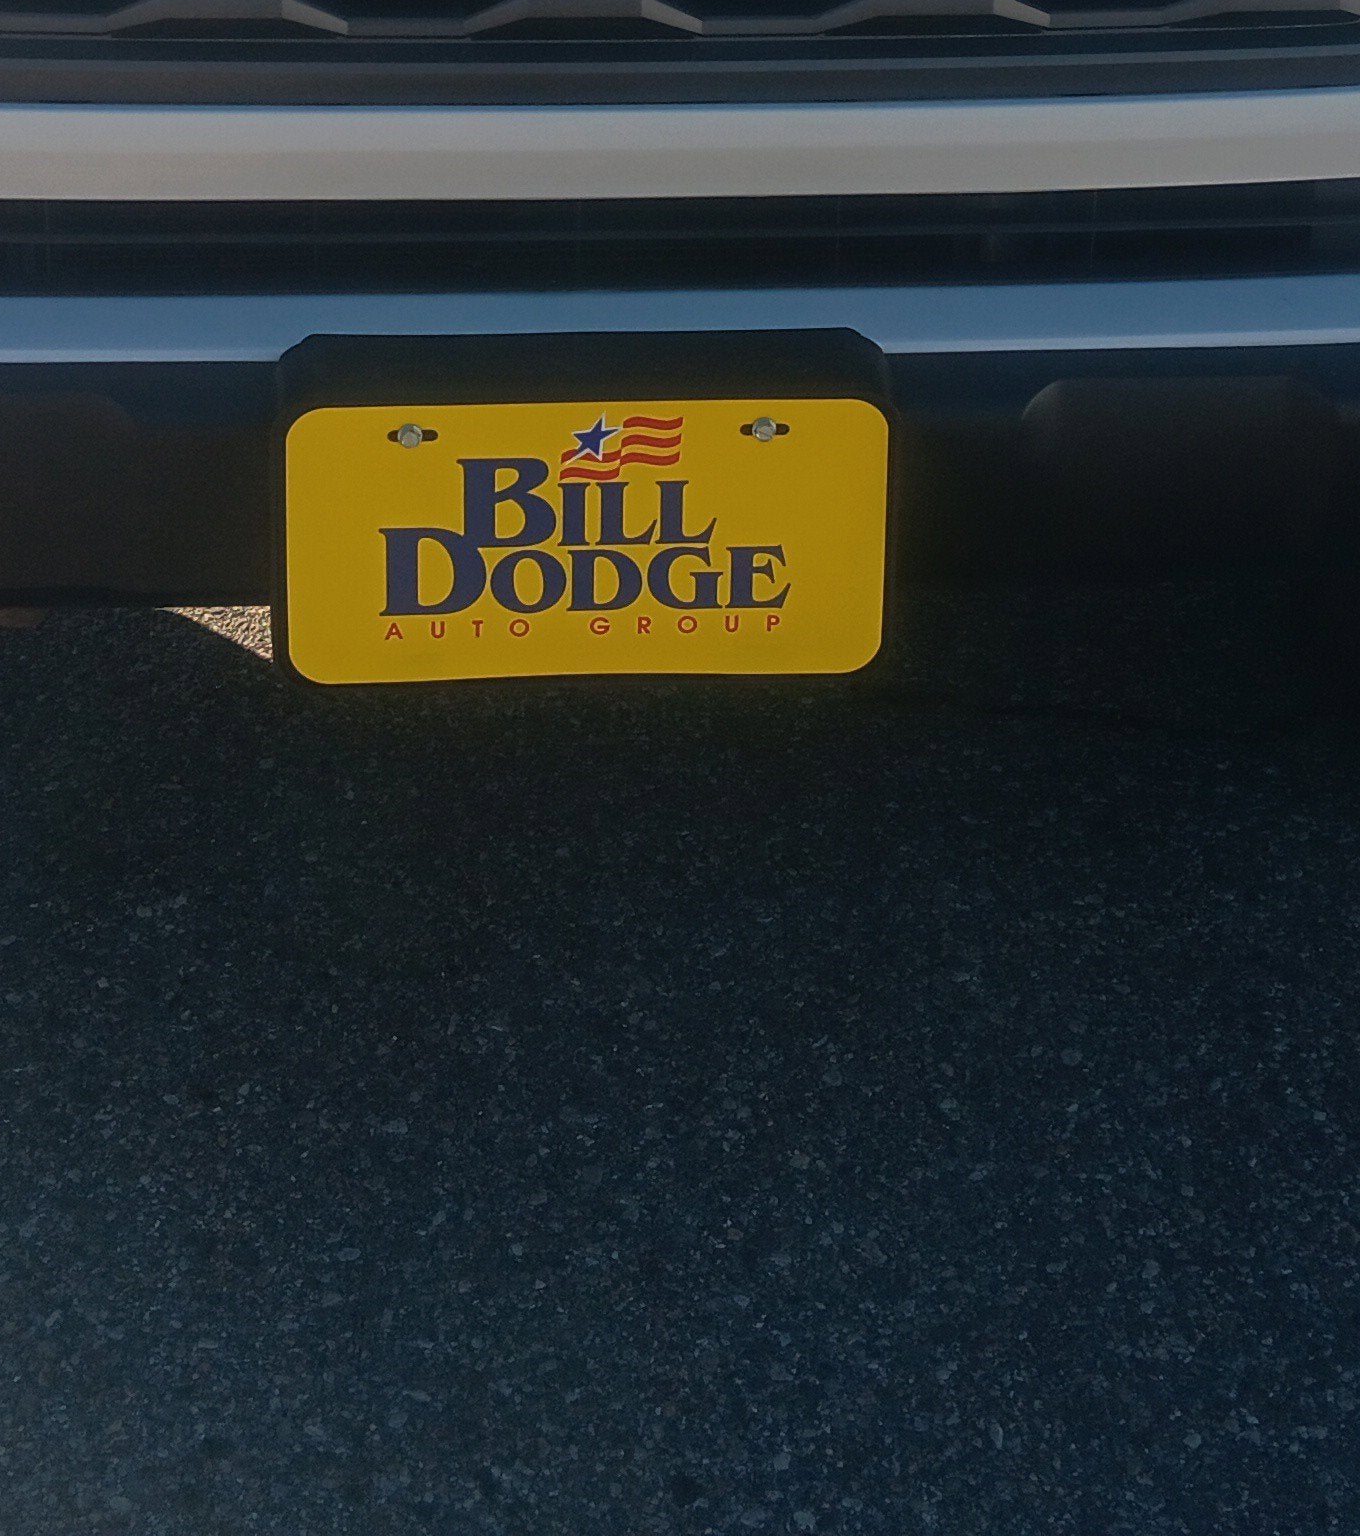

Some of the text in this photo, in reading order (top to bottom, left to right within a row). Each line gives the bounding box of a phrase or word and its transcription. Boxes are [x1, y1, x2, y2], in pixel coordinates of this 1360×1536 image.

[455, 458, 717, 548] BILL
[379, 527, 791, 617] DODGE
[384, 614, 782, 641] AUTO GROUP
